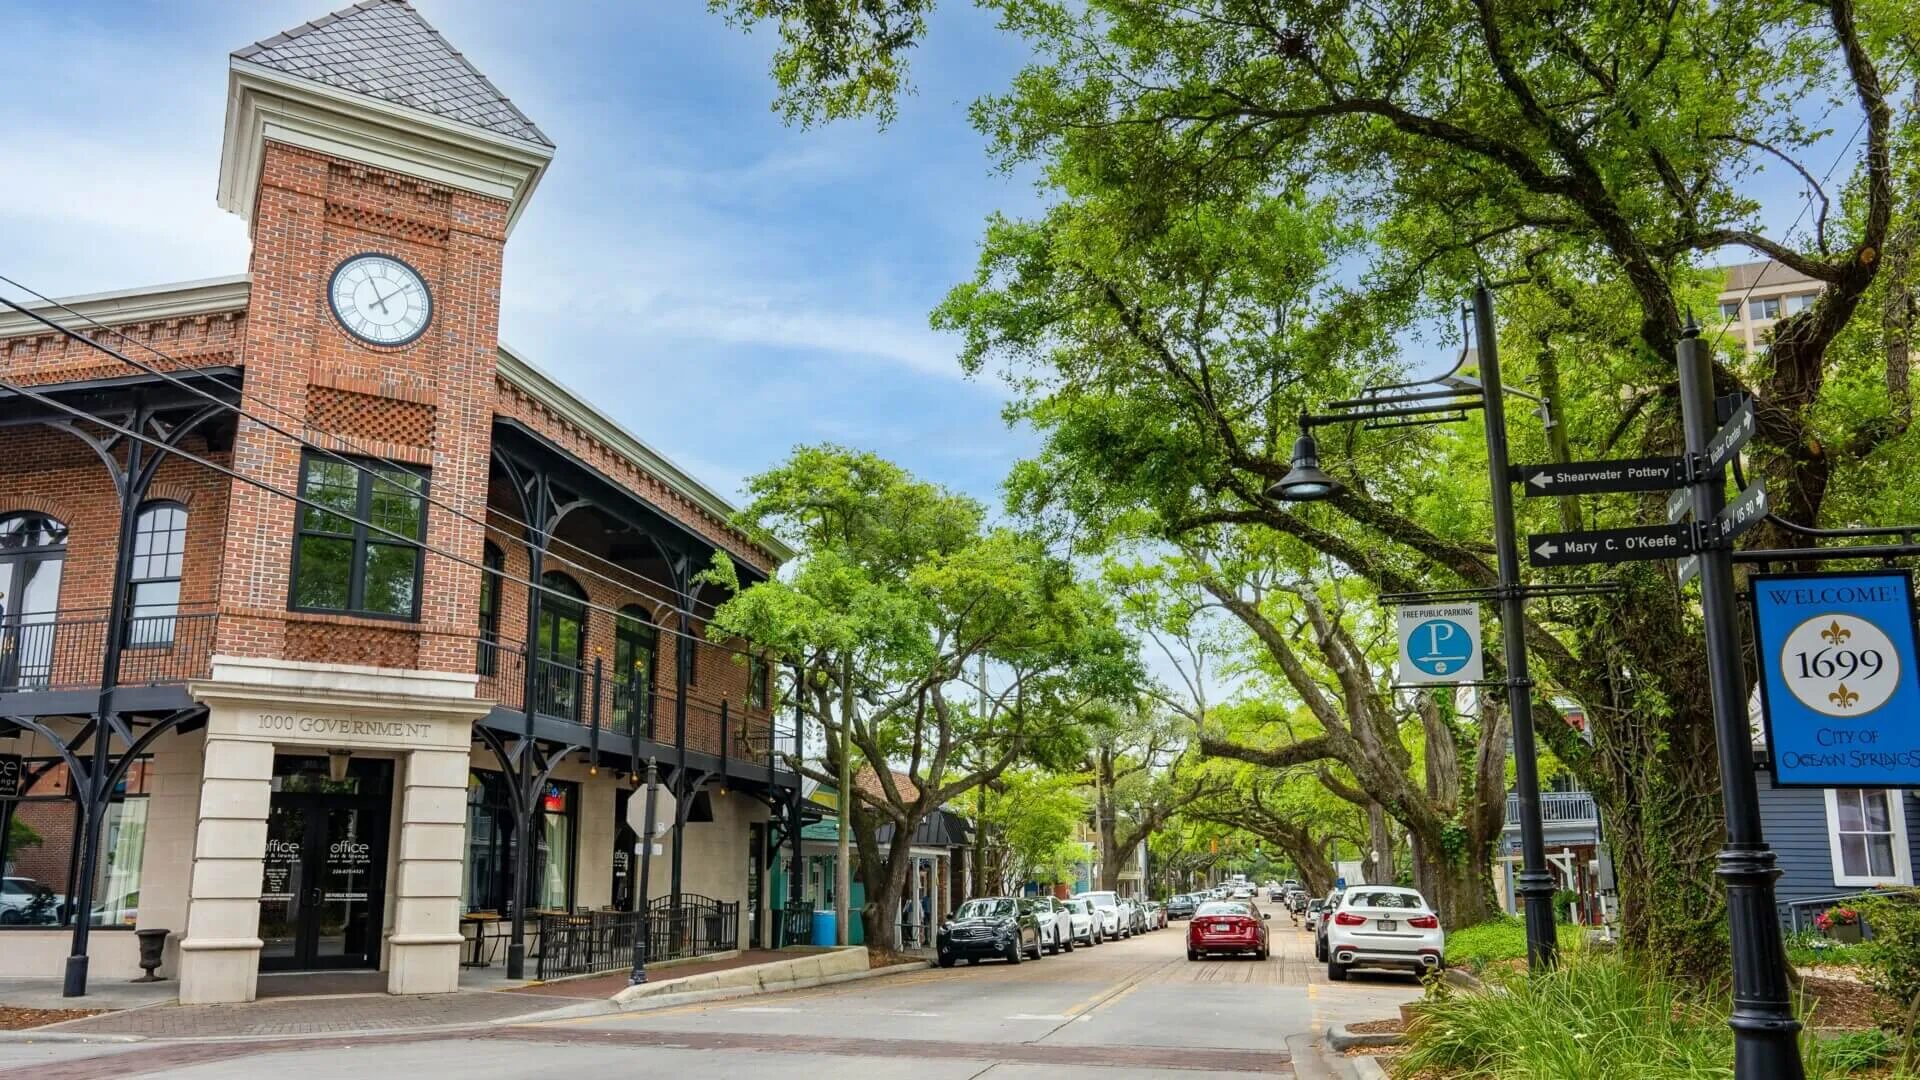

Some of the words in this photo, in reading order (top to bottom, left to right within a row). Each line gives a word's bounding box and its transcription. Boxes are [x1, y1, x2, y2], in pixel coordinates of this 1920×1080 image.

[1725, 425, 1742, 449] Center
[1556, 469, 1622, 484] Shearwater
[1627, 466, 1670, 480] Pottery
[1746, 500, 1755, 517] 90
[1564, 541, 1598, 555] Mary
[1605, 538, 1619, 551] C.
[1625, 534, 1677, 550] O'Keefe
[1768, 586, 1899, 606] WELCOME!
[1402, 610, 1419, 619] FREE
[1419, 609, 1444, 618] PUBLIC
[1444, 607, 1473, 617] PARKING
[1425, 623, 1454, 655] P
[1795, 647, 1883, 681] 1699
[257, 714, 294, 730] 1000
[299, 717, 432, 738] GOVERNMENT
[330, 840, 369, 854] office
